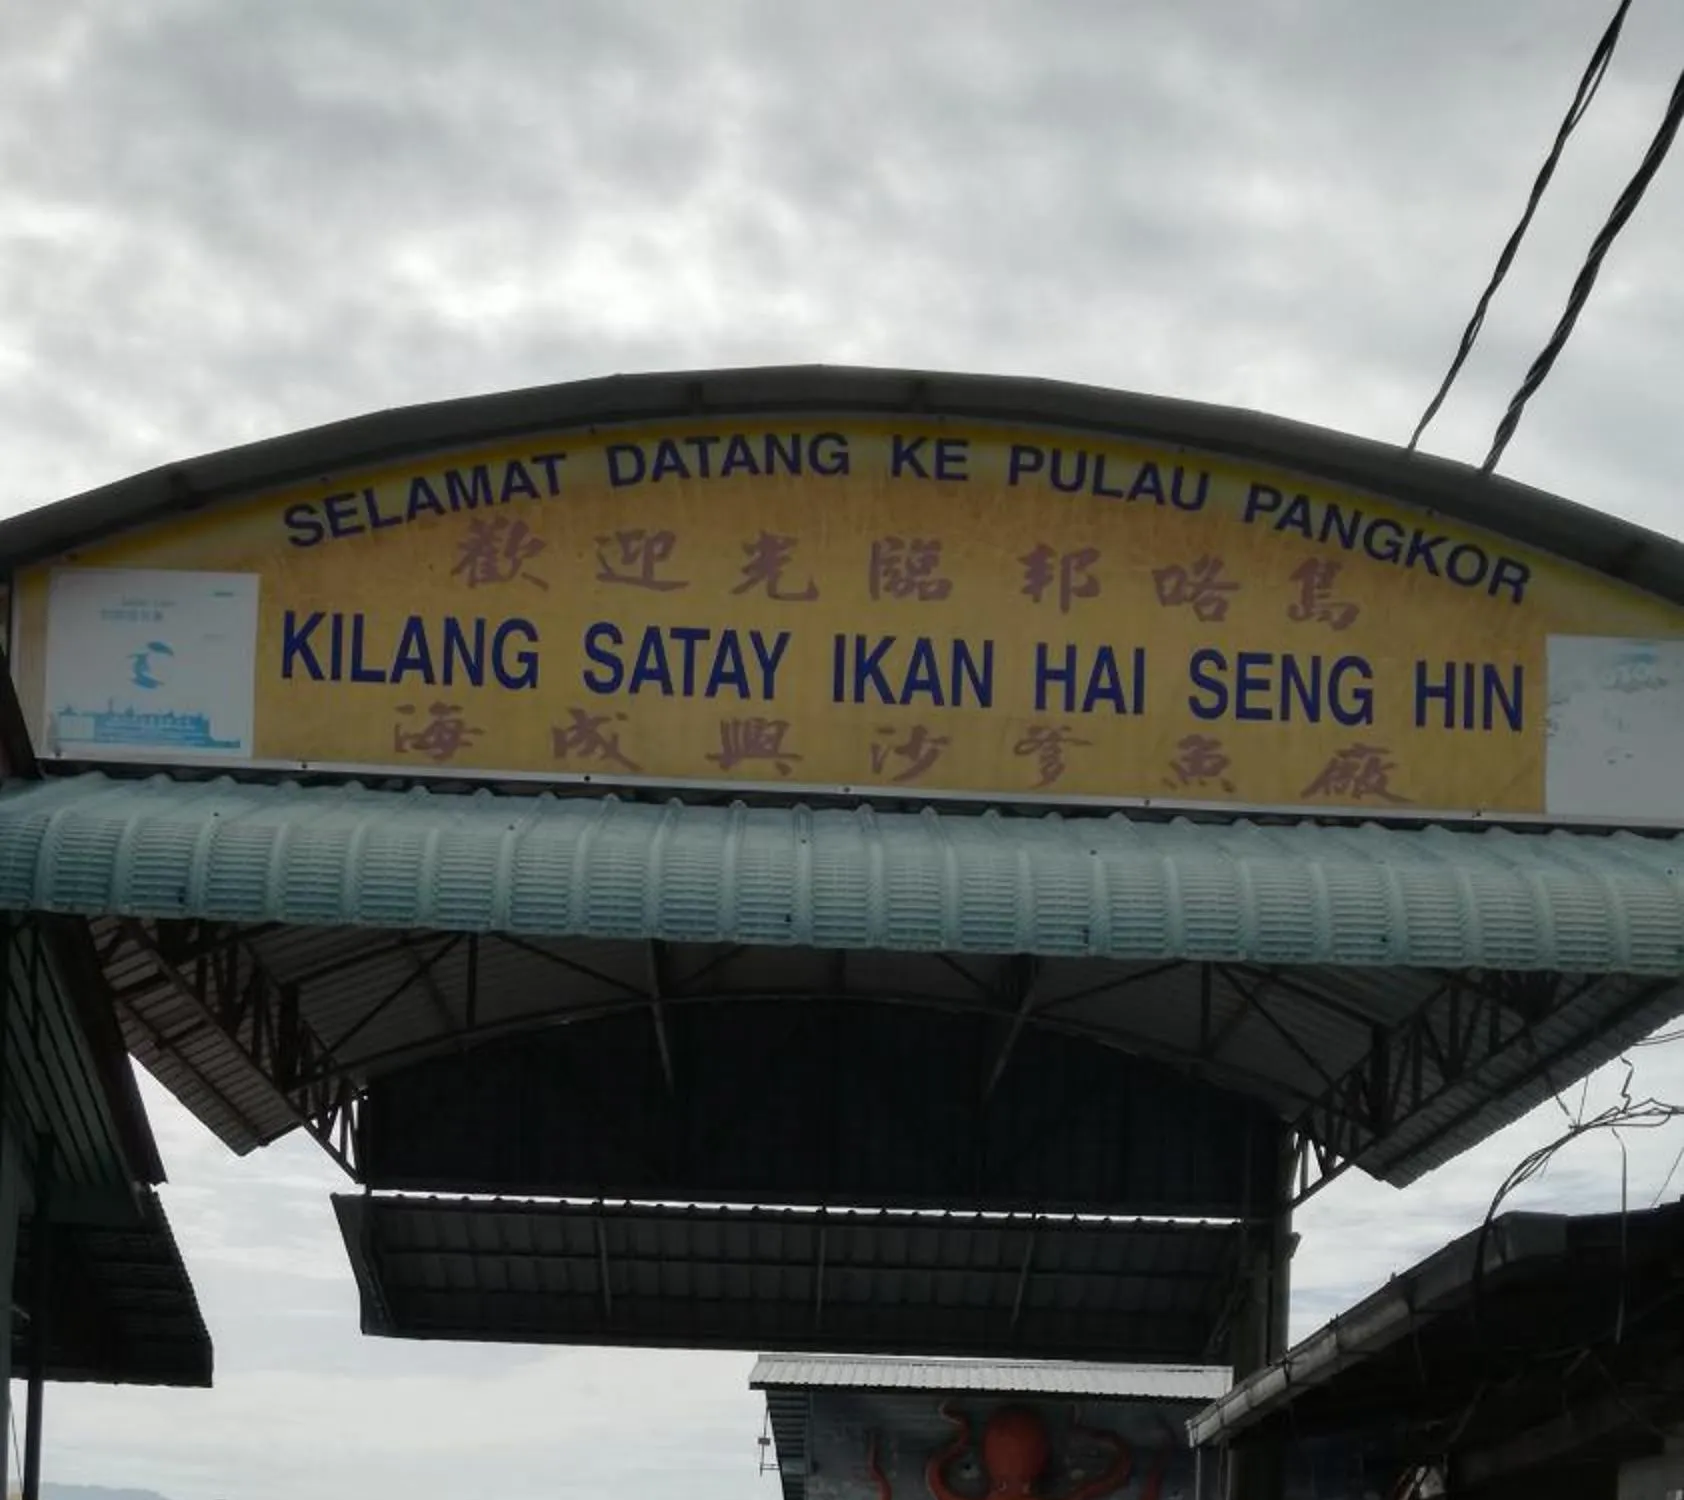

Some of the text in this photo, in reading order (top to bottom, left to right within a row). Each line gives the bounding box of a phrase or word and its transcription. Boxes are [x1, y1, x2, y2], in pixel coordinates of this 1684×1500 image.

[283, 432, 1531, 605] SELAMAT DATANG KE PULAU PANGKOR
[280, 609, 540, 691] KILANG
[582, 620, 792, 702] SATAY
[832, 632, 995, 708] IKAN
[1034, 641, 1147, 716] HAI
[1187, 647, 1375, 727] SENG
[1414, 659, 1525, 733] HIN
